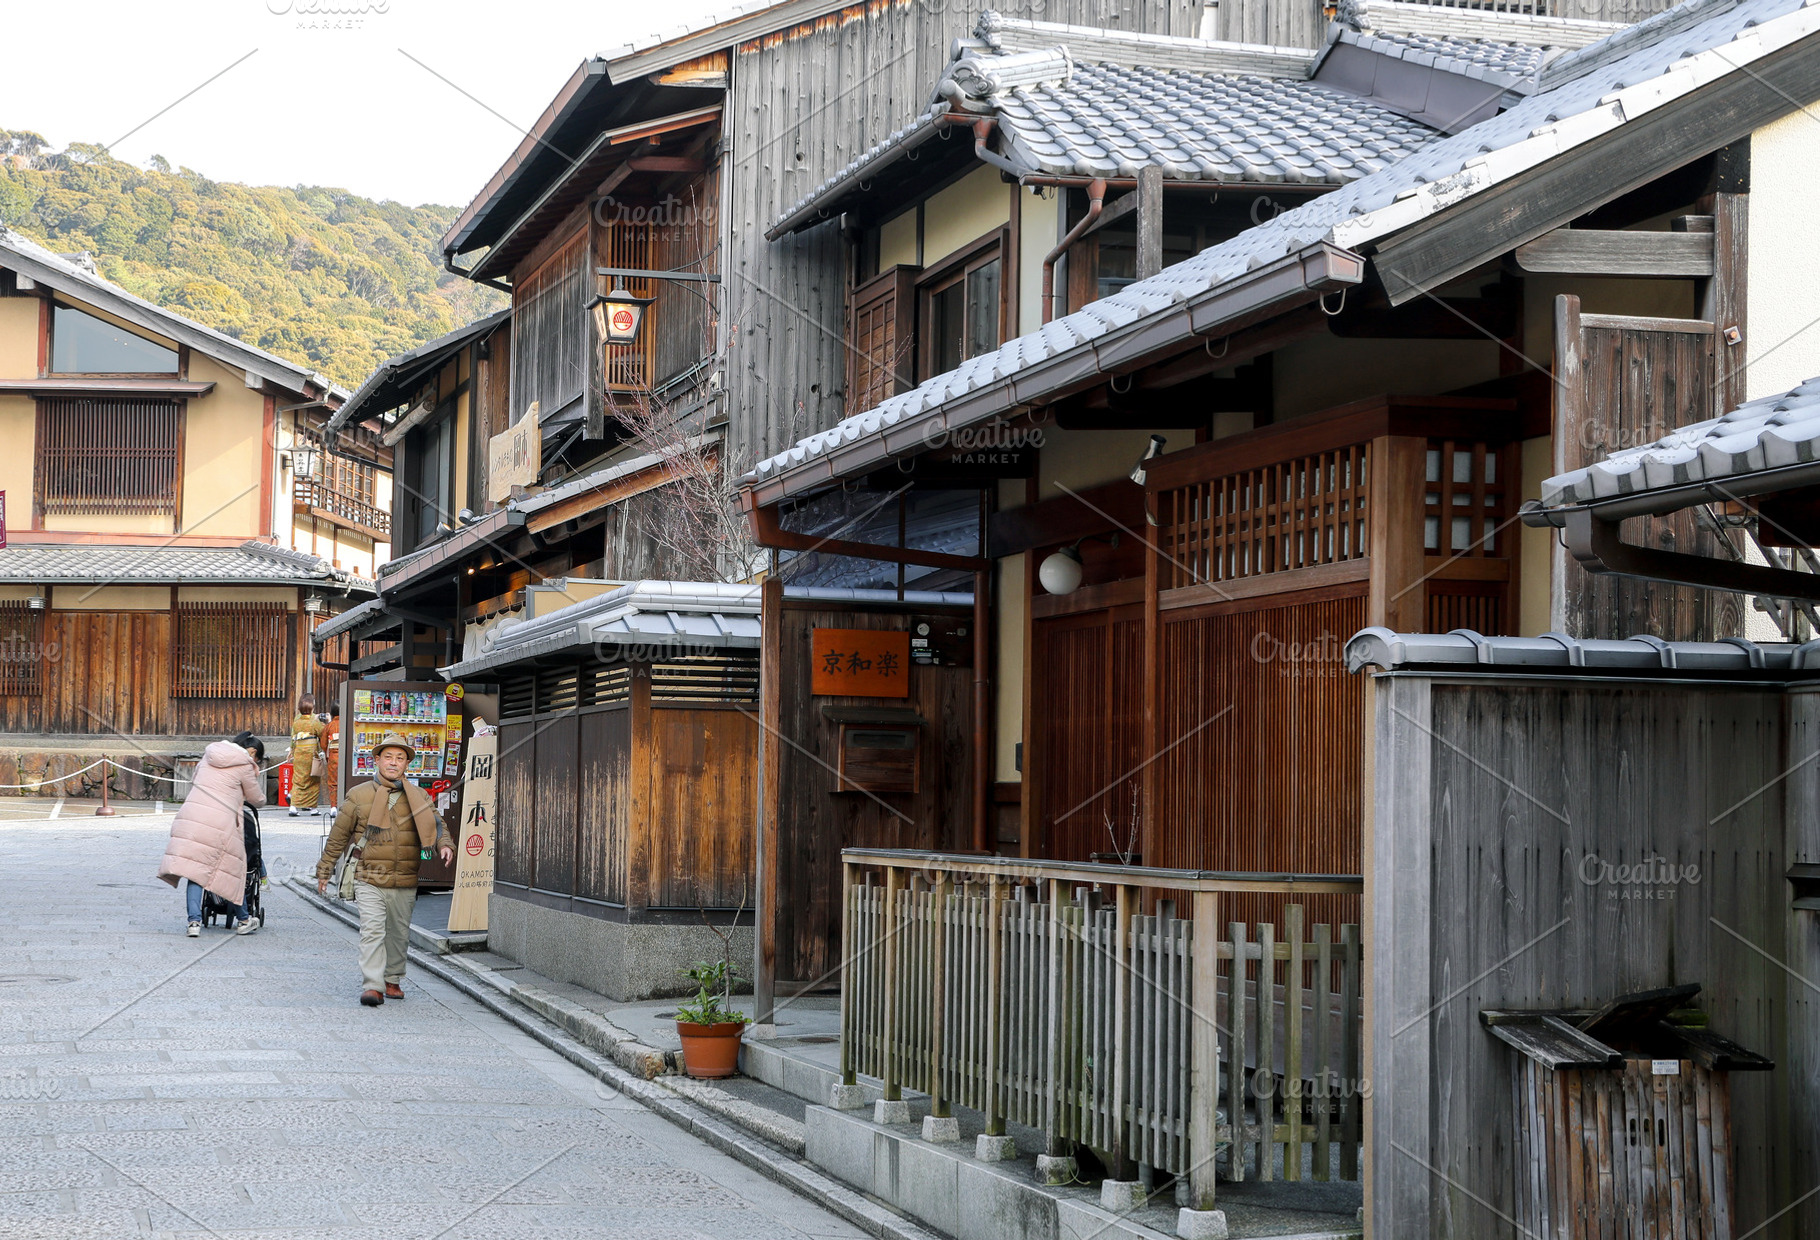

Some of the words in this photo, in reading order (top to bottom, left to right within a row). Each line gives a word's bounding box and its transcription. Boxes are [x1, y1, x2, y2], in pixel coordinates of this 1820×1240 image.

[822, 649, 898, 677] 京和楽
[467, 754, 493, 827] 岡本
[460, 869, 494, 879] OKAMOTO
